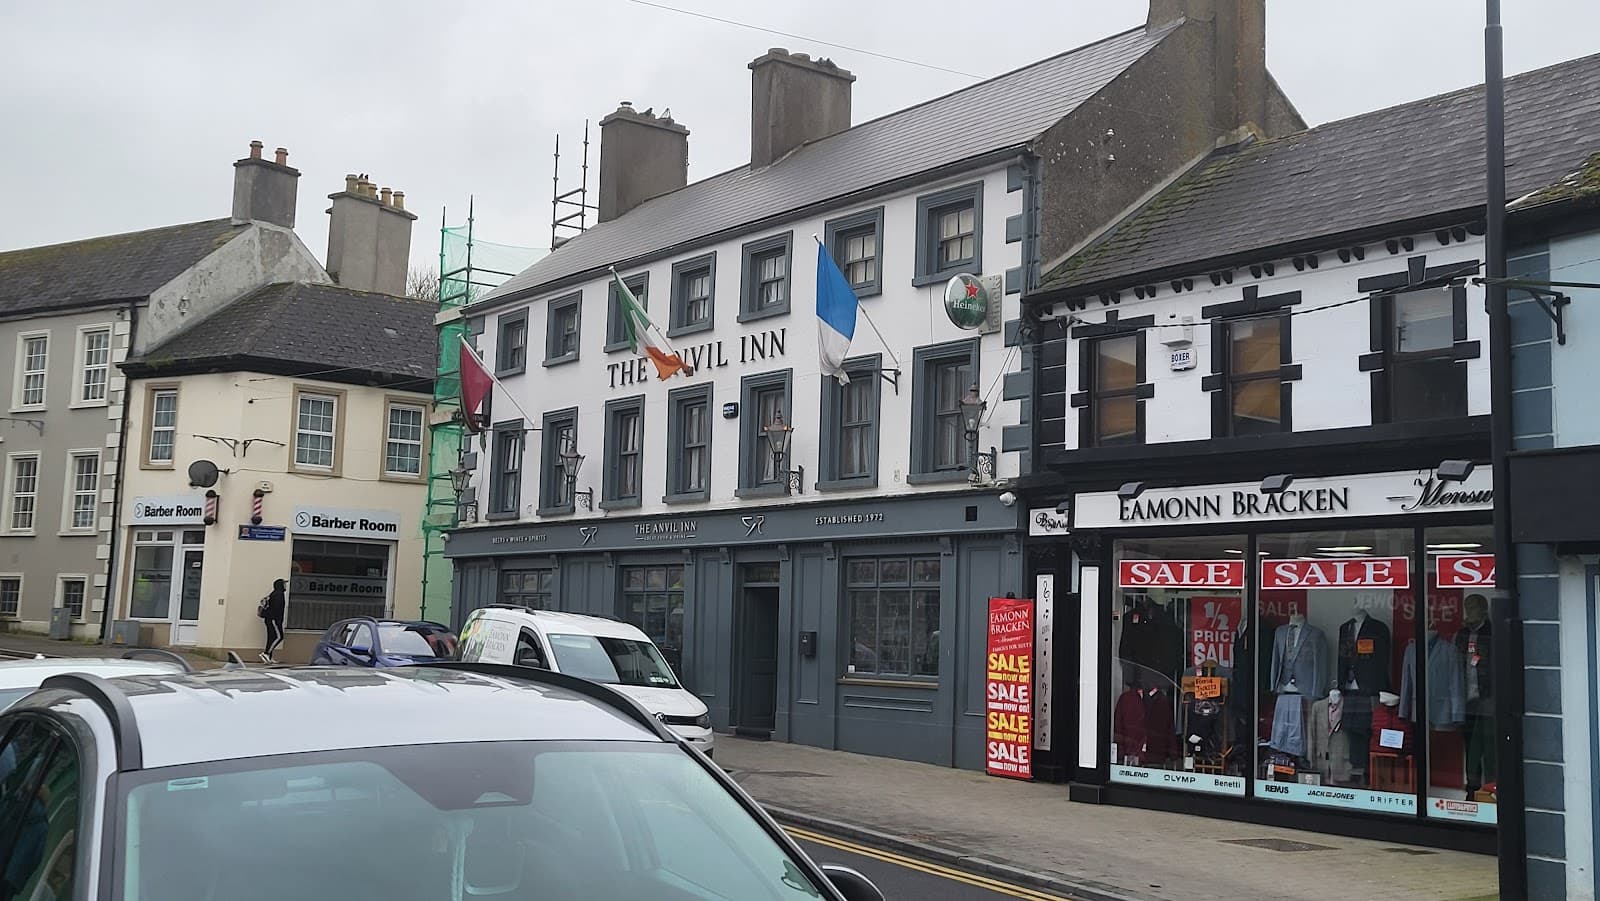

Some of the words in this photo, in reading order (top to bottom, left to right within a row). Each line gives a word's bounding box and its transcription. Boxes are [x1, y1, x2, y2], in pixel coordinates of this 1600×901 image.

[607, 357, 648, 388] THE
[656, 341, 728, 379] NVIL
[740, 328, 787, 363] INN
[1118, 494, 1222, 521] EAMONN
[1231, 486, 1351, 516] BRACKEN
[144, 505, 174, 517] Barber
[176, 505, 202, 517] Room
[312, 515, 356, 530] Barber
[359, 518, 397, 532] Room
[815, 514, 863, 525] ESTABLISHED
[865, 513, 883, 522] 1972
[634, 523, 650, 534] THE
[652, 522, 678, 533] ANVIL
[680, 521, 697, 532] INN
[1130, 563, 1232, 585] SALE
[1274, 559, 1394, 586] SALE
[309, 581, 348, 592] Barber
[350, 582, 383, 593] Room
[990, 609, 1029, 624] EAMONN
[991, 620, 1030, 635] BRACKEN
[989, 652, 1030, 673] SALE
[1002, 673, 1018, 682] now
[988, 682, 1030, 703] SALE
[1004, 703, 1018, 712] now
[989, 711, 1030, 734] SALE
[1003, 732, 1018, 741] now
[988, 742, 1029, 764] SALE
[1003, 762, 1018, 772] now
[1125, 770, 1149, 778] BLEND
[1164, 774, 1196, 784] OLYMP
[1214, 778, 1241, 788] Benetti
[1370, 795, 1414, 806] DRIFTER
